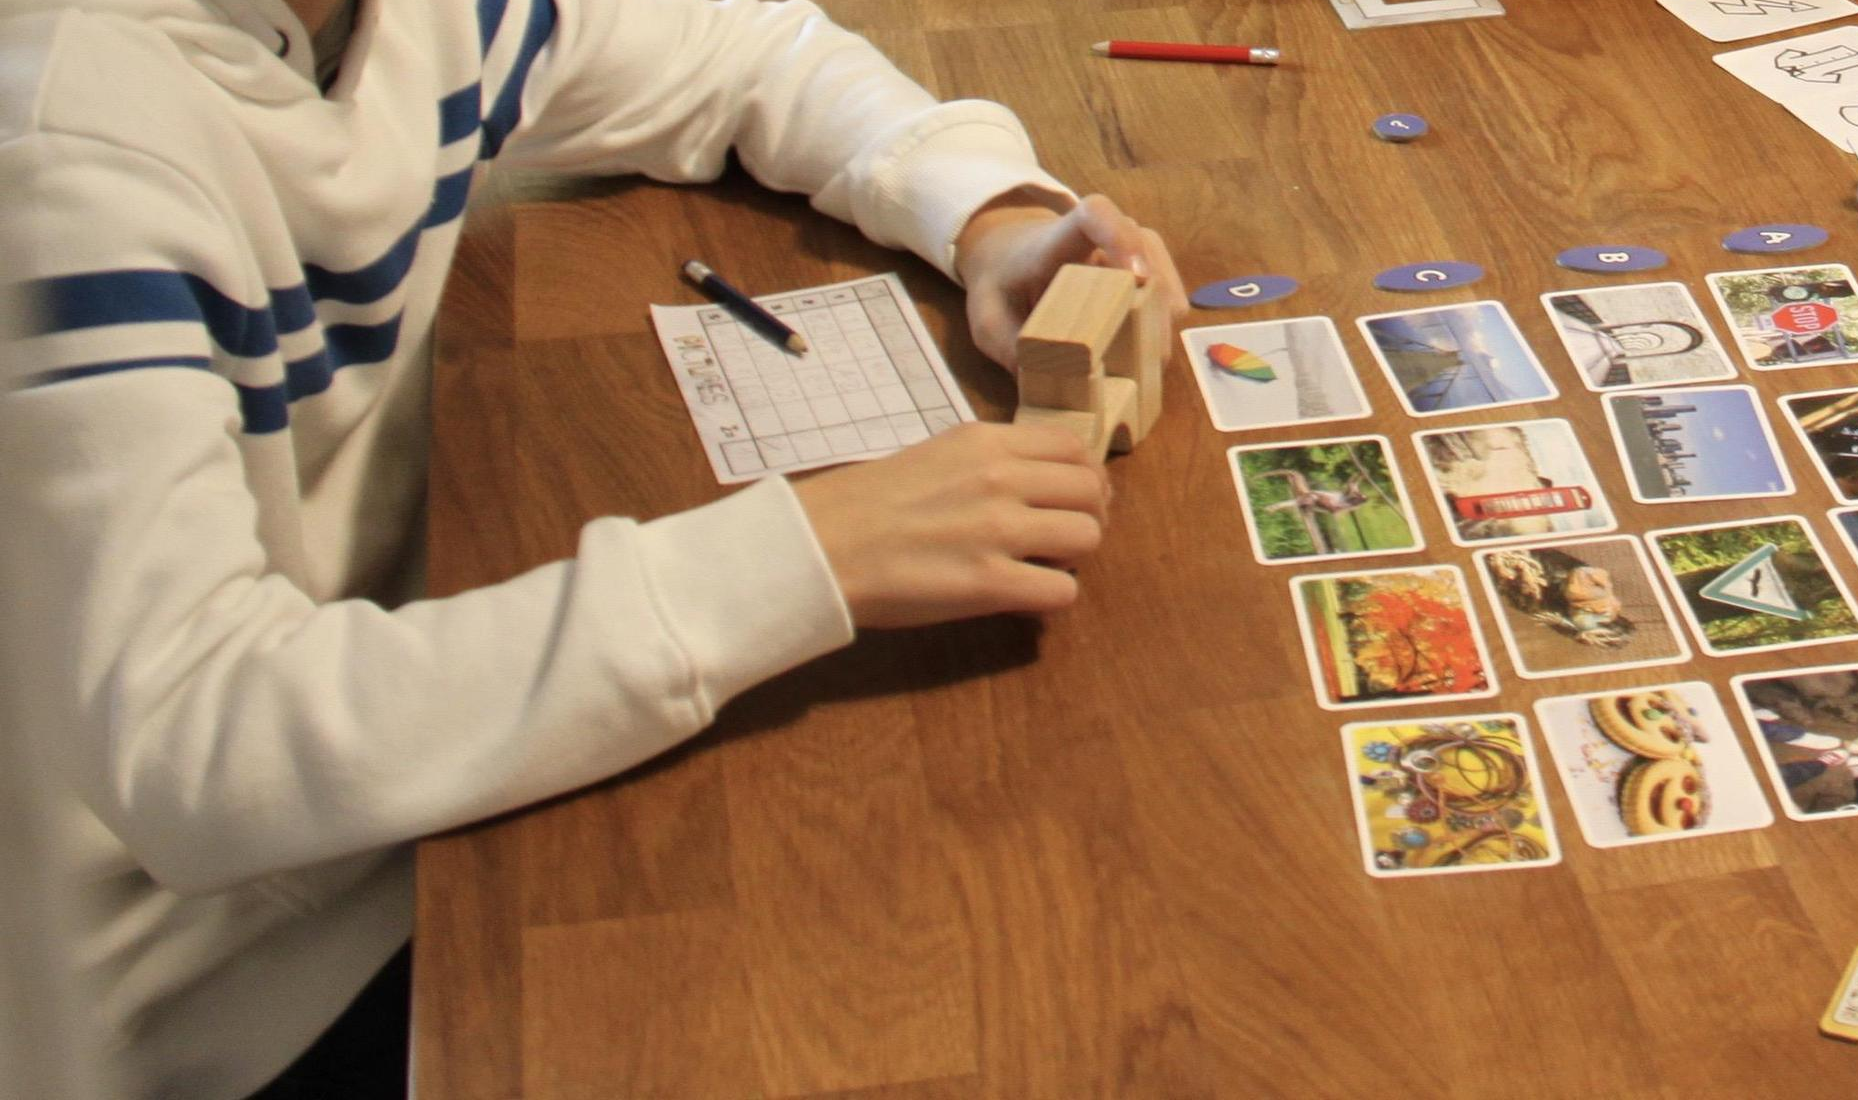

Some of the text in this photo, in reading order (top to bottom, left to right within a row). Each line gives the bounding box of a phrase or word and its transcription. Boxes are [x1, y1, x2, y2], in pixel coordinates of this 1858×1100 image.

[1760, 229, 1792, 247] A
[1597, 250, 1629, 264] B
[1413, 268, 1447, 284] C
[1236, 282, 1261, 298] D
[1789, 304, 1821, 330] STOP
